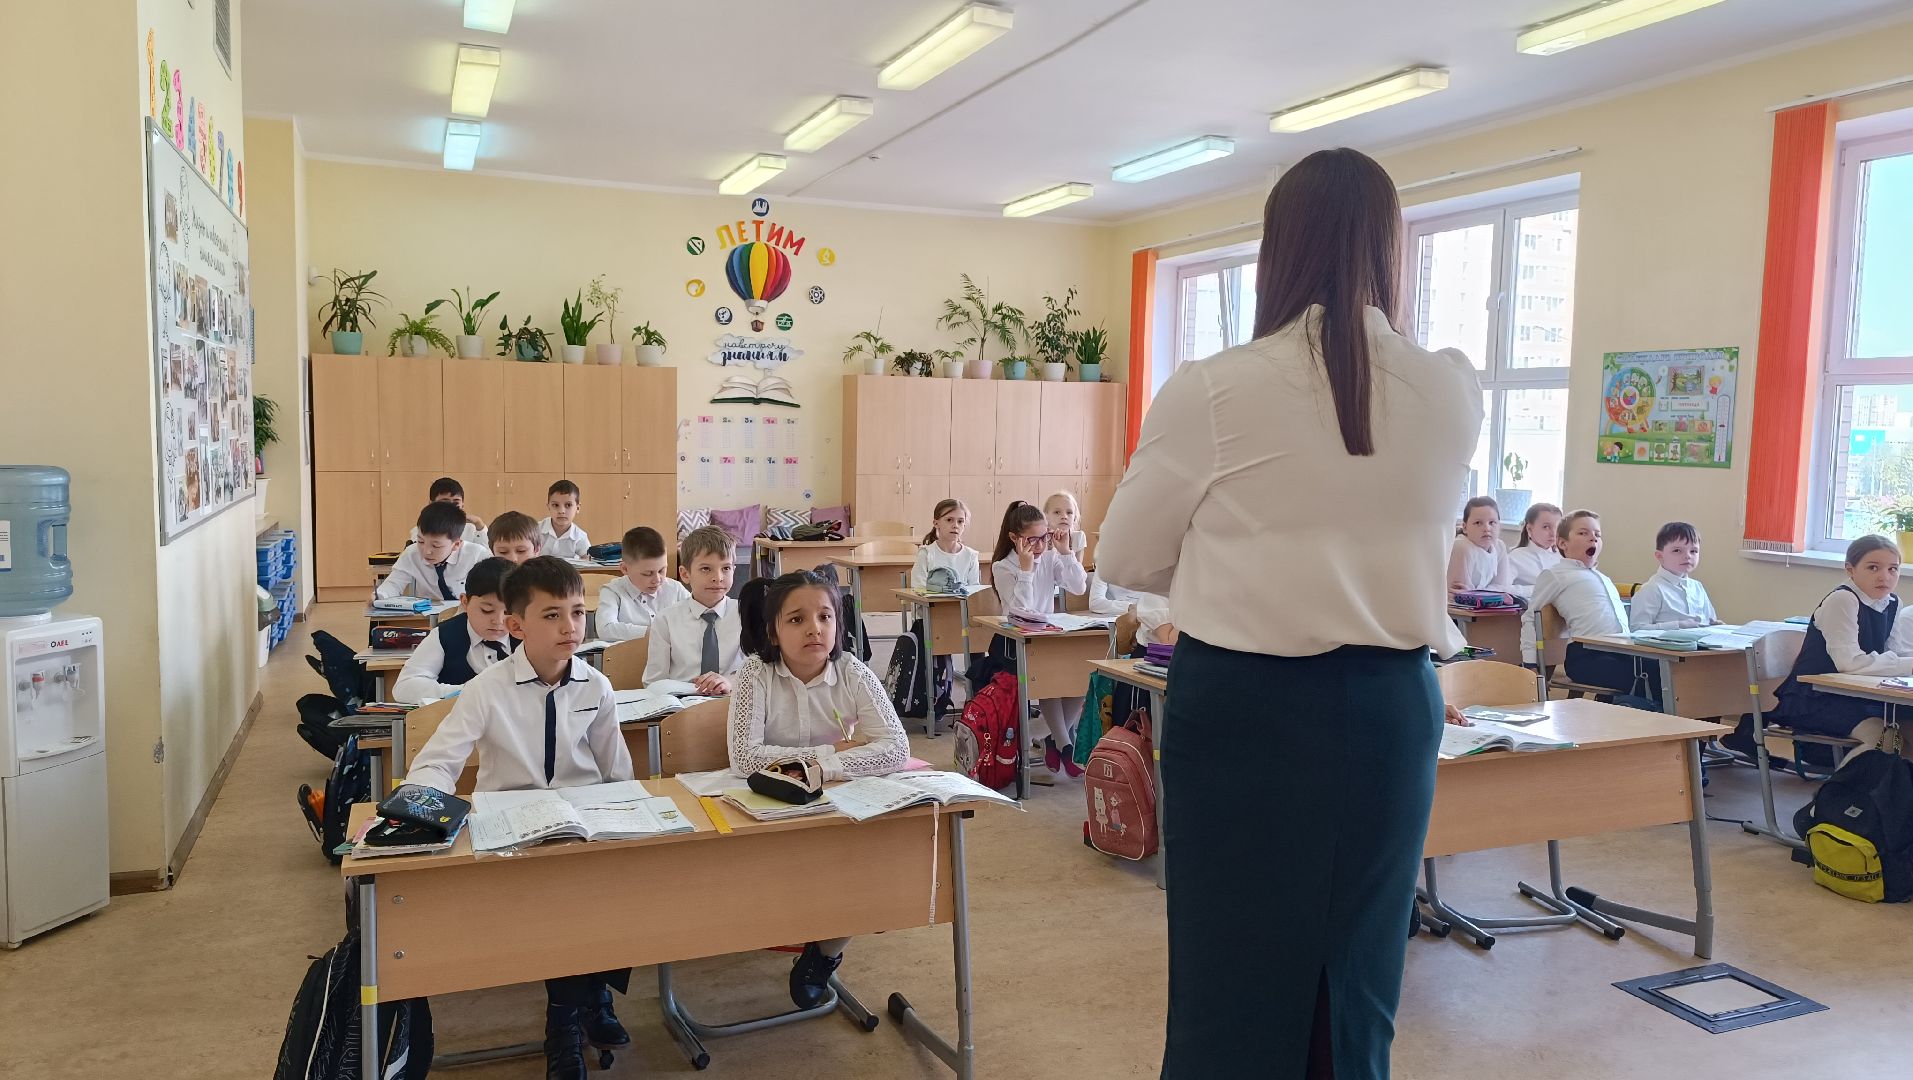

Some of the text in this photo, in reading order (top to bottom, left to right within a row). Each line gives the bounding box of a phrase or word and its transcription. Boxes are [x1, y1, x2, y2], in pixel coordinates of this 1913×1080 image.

[147, 28, 156, 120] 1
[160, 60, 173, 138] 2
[173, 69, 184, 151] 3
[716, 220, 805, 256] ЛЕТИМ
[724, 338, 786, 352] навстречу
